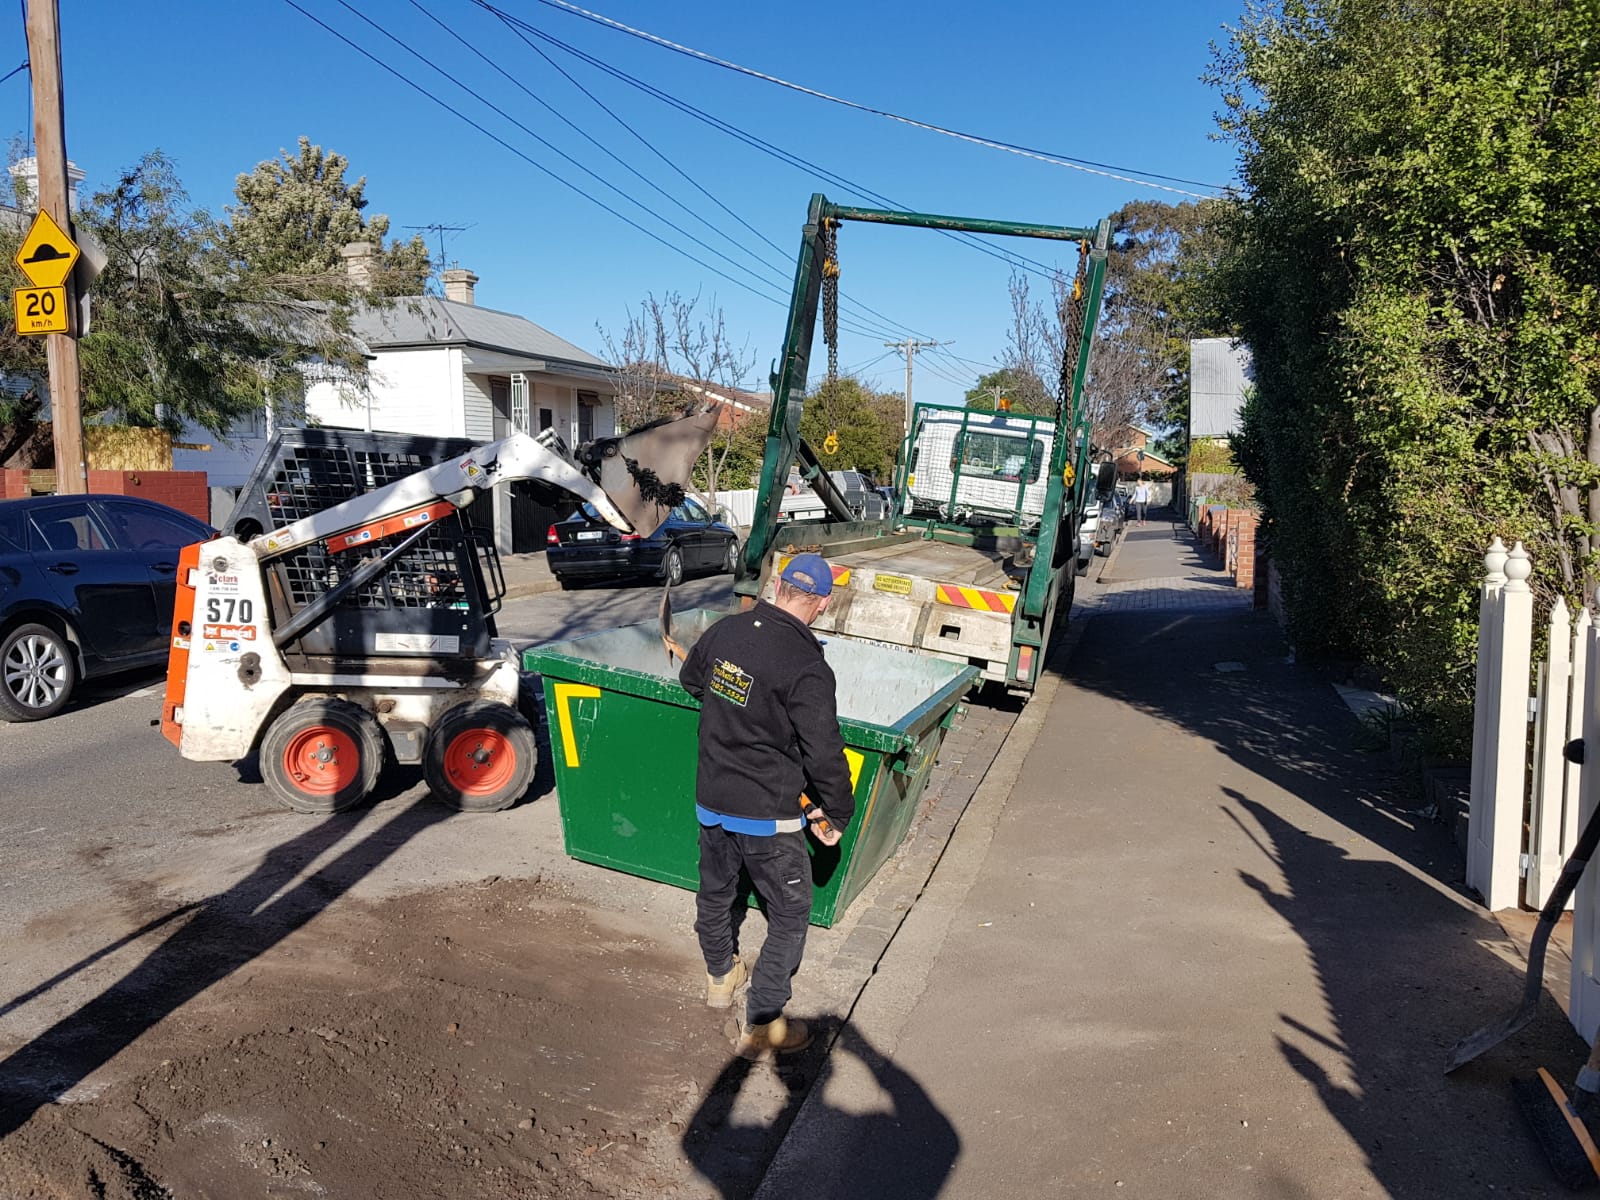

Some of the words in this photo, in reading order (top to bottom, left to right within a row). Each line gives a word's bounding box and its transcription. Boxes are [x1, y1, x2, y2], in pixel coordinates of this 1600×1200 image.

[26, 292, 55, 316] 20
[31, 319, 53, 328] km/h
[207, 598, 253, 623] S70
